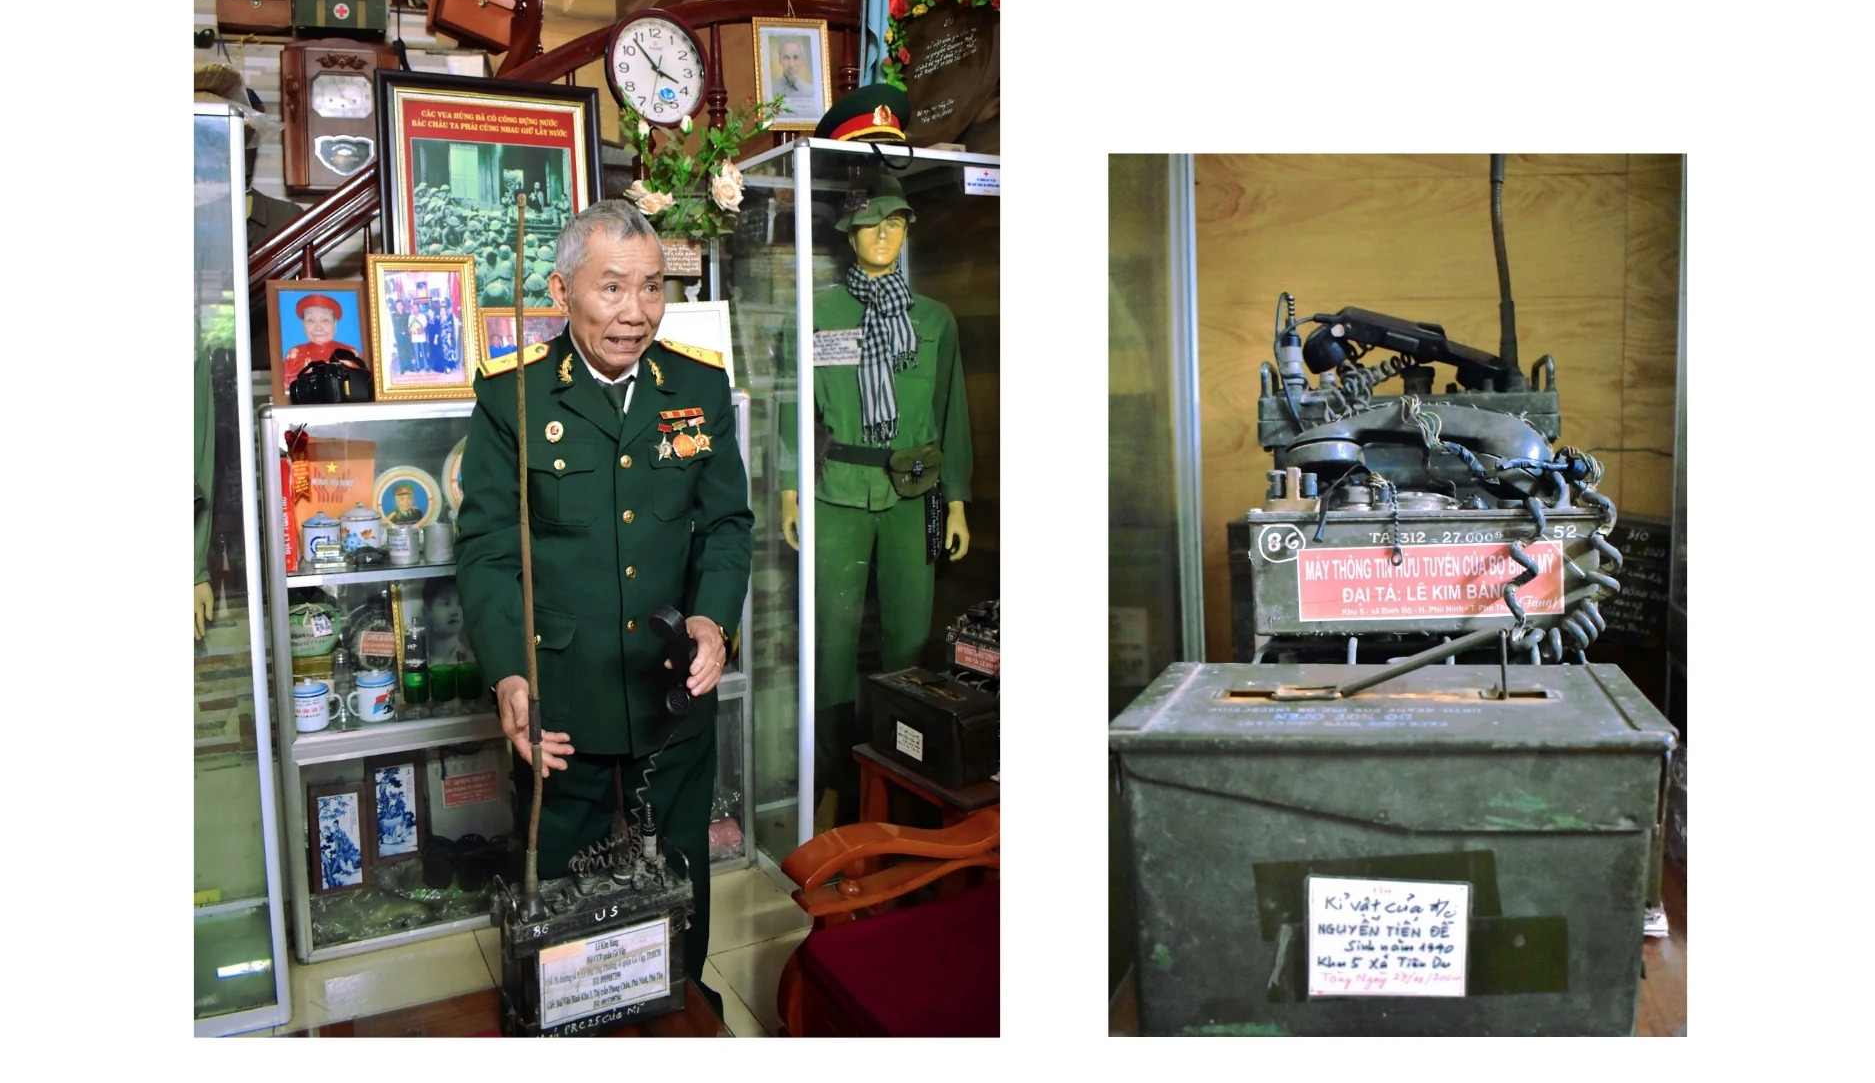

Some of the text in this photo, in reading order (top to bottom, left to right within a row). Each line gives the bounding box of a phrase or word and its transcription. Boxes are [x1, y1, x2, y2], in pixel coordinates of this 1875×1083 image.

[634, 31, 644, 42] 11
[649, 28, 661, 38] 12
[670, 35, 674, 45] 1
[623, 45, 636, 56] 10
[678, 50, 688, 61] 2
[618, 62, 629, 73] 9
[683, 68, 693, 79] 3
[624, 81, 635, 92] 8
[679, 86, 689, 96] 4
[638, 96, 646, 107] 7
[653, 103, 664, 114] 6
[421, 109, 436, 118] CÁC
[437, 111, 452, 119] VUA
[454, 111, 474, 121] HÙNG
[475, 112, 486, 121] ĐÃ
[486, 113, 497, 122] CÓ
[498, 114, 517, 124] CÔNG
[412, 119, 426, 127] BÁC
[428, 120, 448, 129] CHÁU
[450, 122, 459, 130] TA
[461, 122, 478, 131] PHẢI
[479, 123, 499, 133] CÙNG
[501, 125, 520, 134] NHAU
[1553, 525, 1577, 539] 52
[1268, 532, 1300, 553] 86
[1305, 555, 1329, 581] MÁY
[1332, 554, 1372, 580] THÔNG
[1374, 559, 1392, 579] TIN
[1422, 551, 1460, 578] TUYẾN
[1462, 550, 1487, 577] CỦA
[1489, 551, 1505, 580] BỘ
[1538, 548, 1554, 575] MỸ
[1342, 587, 1370, 606] ĐẠI
[1374, 583, 1401, 603] TÁ:
[1406, 582, 1427, 602] LÊ
[1432, 585, 1461, 600] KIM
[1342, 607, 1357, 615] Khu
[1401, 606, 1412, 616] Bộ
[1418, 606, 1428, 614] H.
[1446, 604, 1464, 612] Ninh
[1384, 893, 1424, 914] của
[533, 924, 549, 937] 86
[1318, 914, 1381, 936] NGUYỄN
[1386, 916, 1421, 938] TIẾN
[1344, 940, 1375, 952] Sinh
[1317, 956, 1346, 968] Khu
[1351, 957, 1362, 969] 5
[1432, 956, 1452, 969] Du
[565, 1021, 585, 1035] PRC
[588, 1015, 601, 1027] 25
